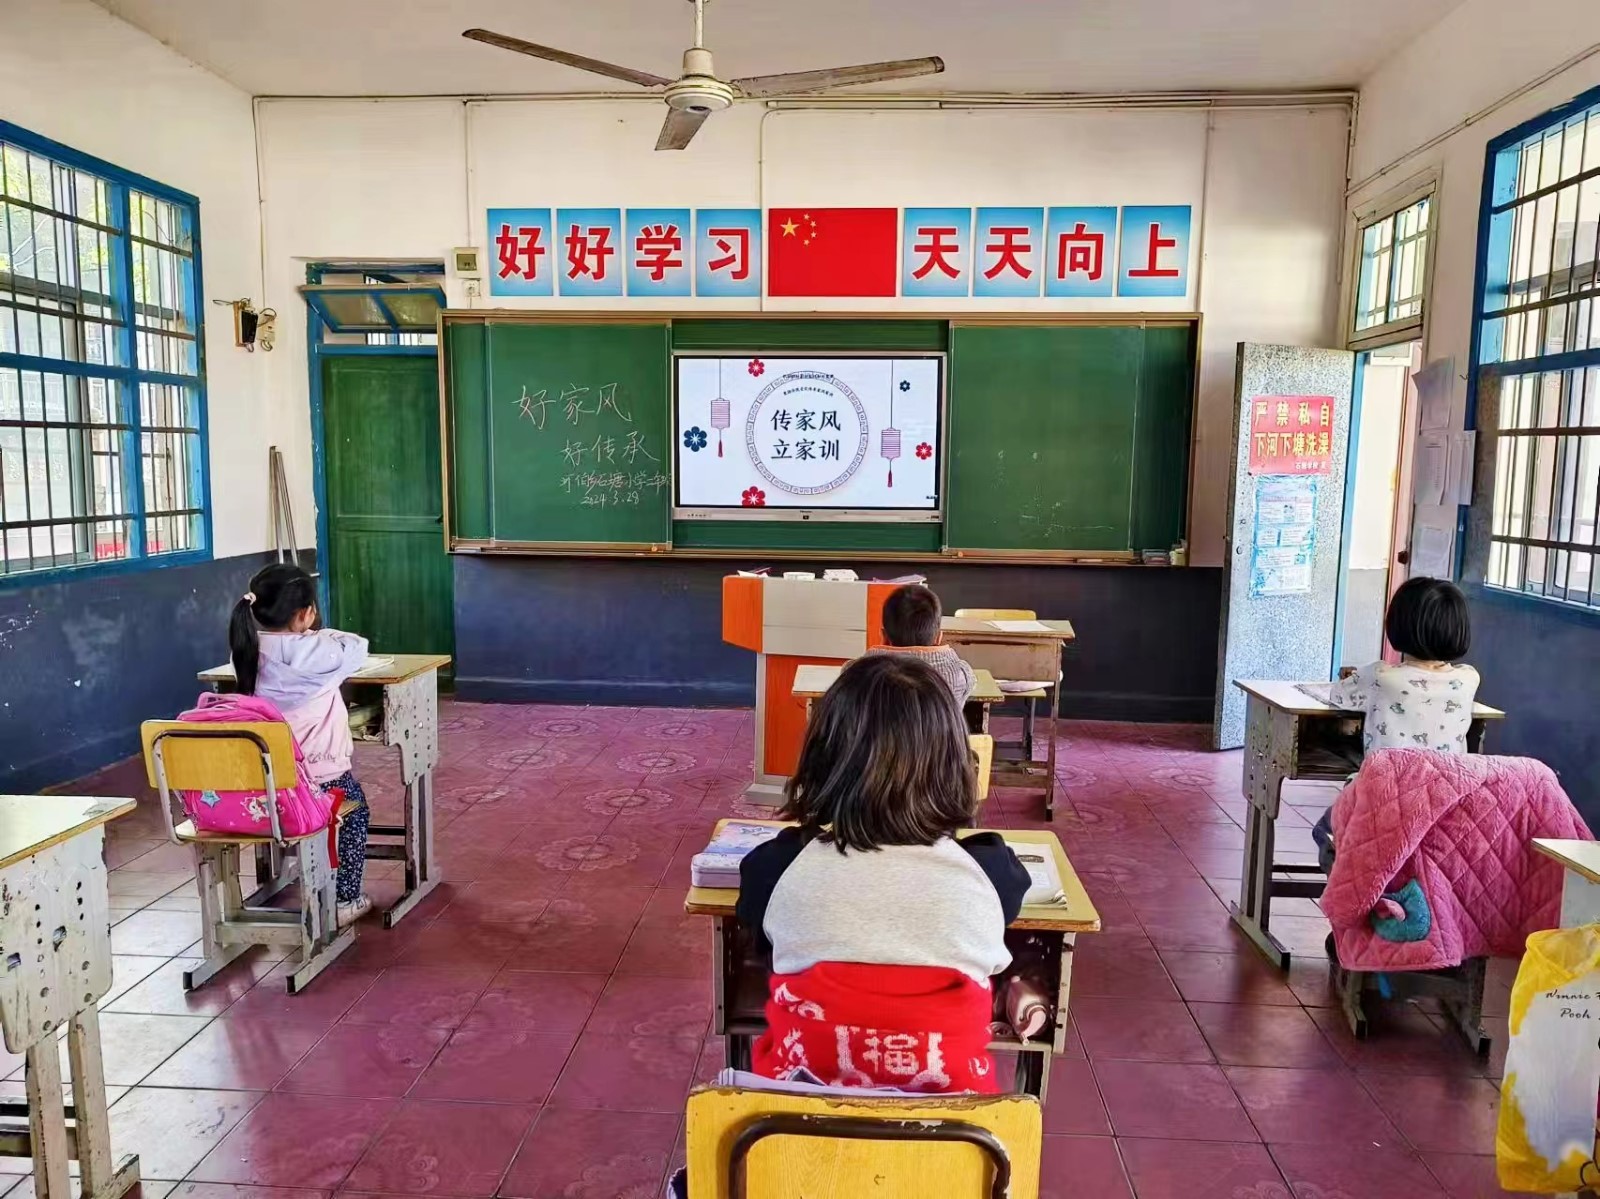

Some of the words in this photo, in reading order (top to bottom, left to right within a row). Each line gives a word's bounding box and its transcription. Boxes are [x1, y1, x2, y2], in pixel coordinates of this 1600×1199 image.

[495, 224, 750, 281] 好好学习
[911, 222, 1180, 281] 天天向上
[511, 382, 632, 430] 好家风
[1254, 401, 1331, 427] 严禁私自
[770, 408, 841, 432] 传家风
[560, 430, 660, 468] 好传承
[770, 438, 840, 461] 立家训
[1253, 431, 1330, 458] 下河下塘洗澡
[1560, 1007, 1592, 1020] Pooh
[862, 1033, 920, 1077] 福
